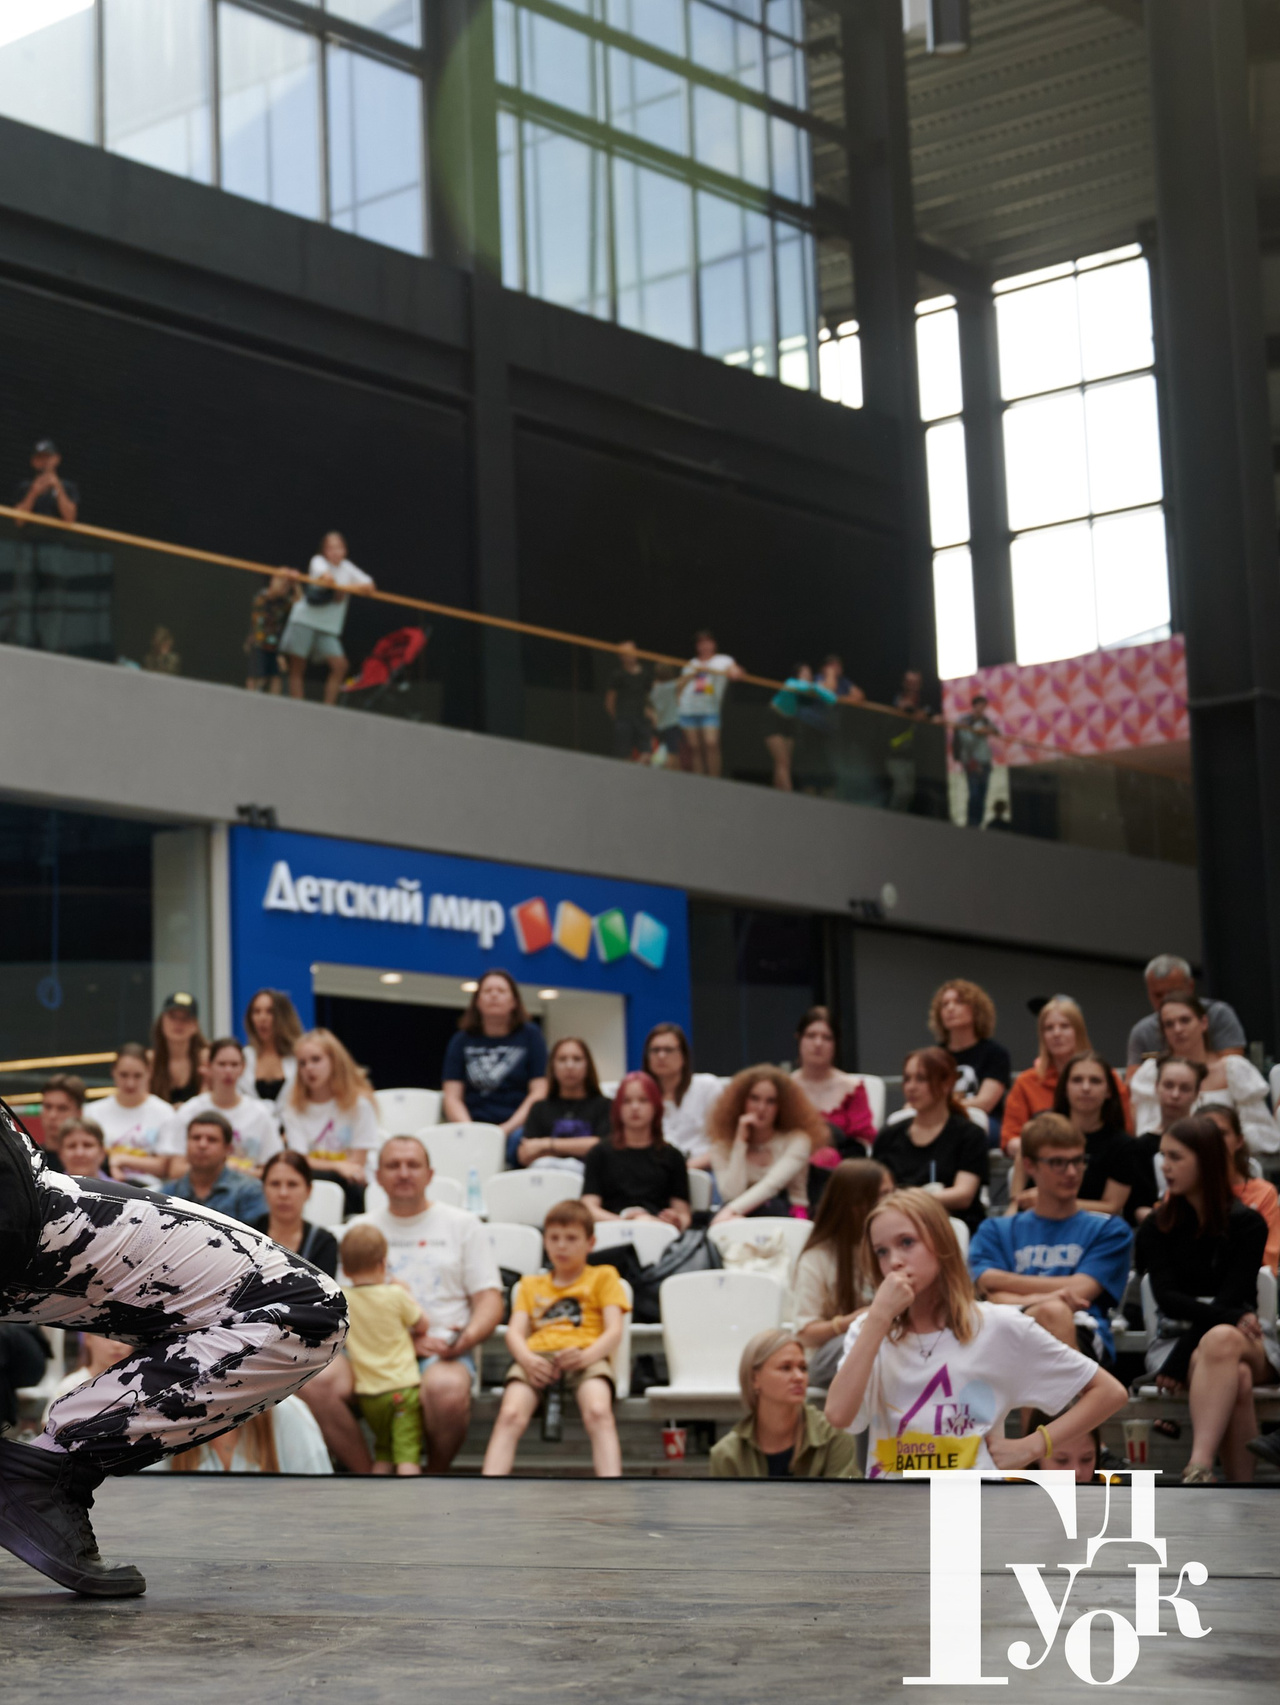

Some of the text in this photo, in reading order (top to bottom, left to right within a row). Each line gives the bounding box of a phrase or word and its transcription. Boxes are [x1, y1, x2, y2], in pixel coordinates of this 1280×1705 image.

[264, 861, 505, 949] Детский мир
[896, 1440, 936, 1454] Dance
[895, 1453, 958, 1471] BATTLE
